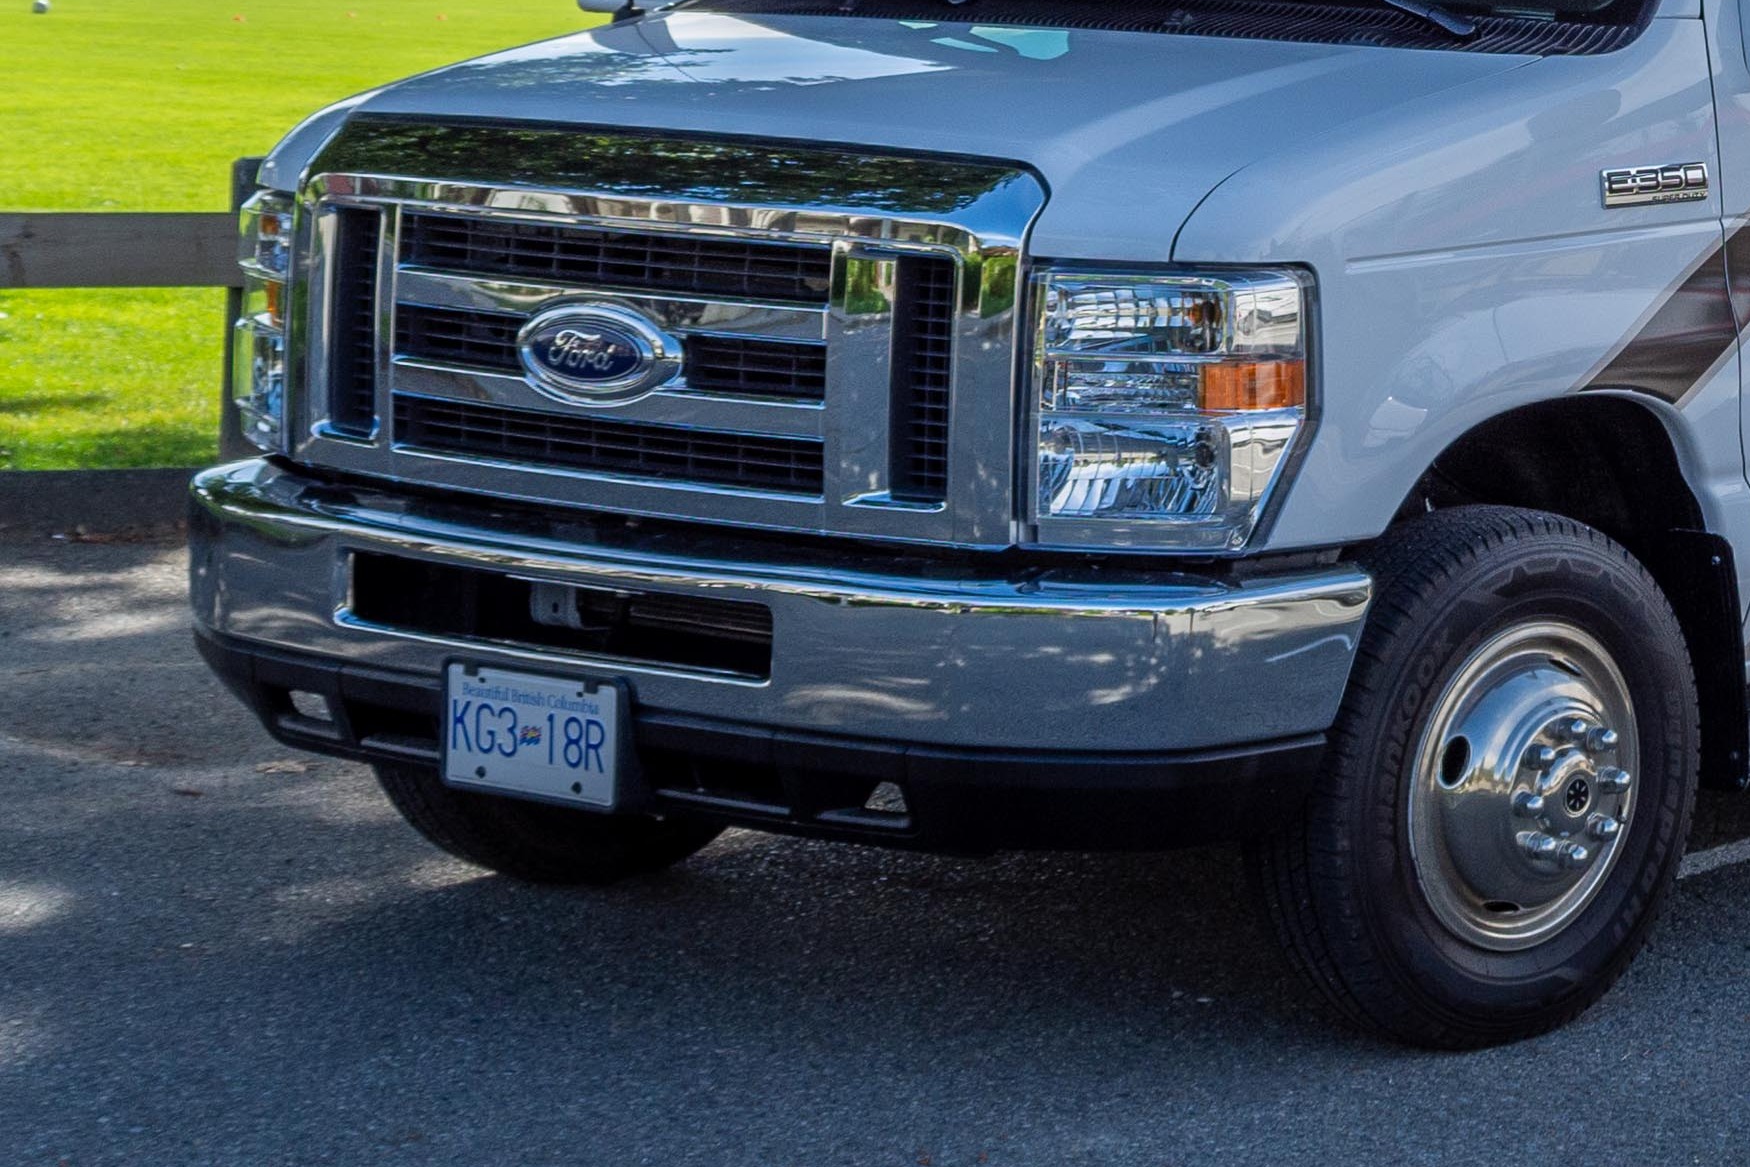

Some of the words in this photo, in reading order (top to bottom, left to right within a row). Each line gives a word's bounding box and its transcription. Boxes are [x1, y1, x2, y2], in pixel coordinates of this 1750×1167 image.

[548, 329, 617, 371] Ford
[462, 682, 509, 702] Beautiful
[511, 688, 545, 707] British
[547, 695, 600, 715] Columbia
